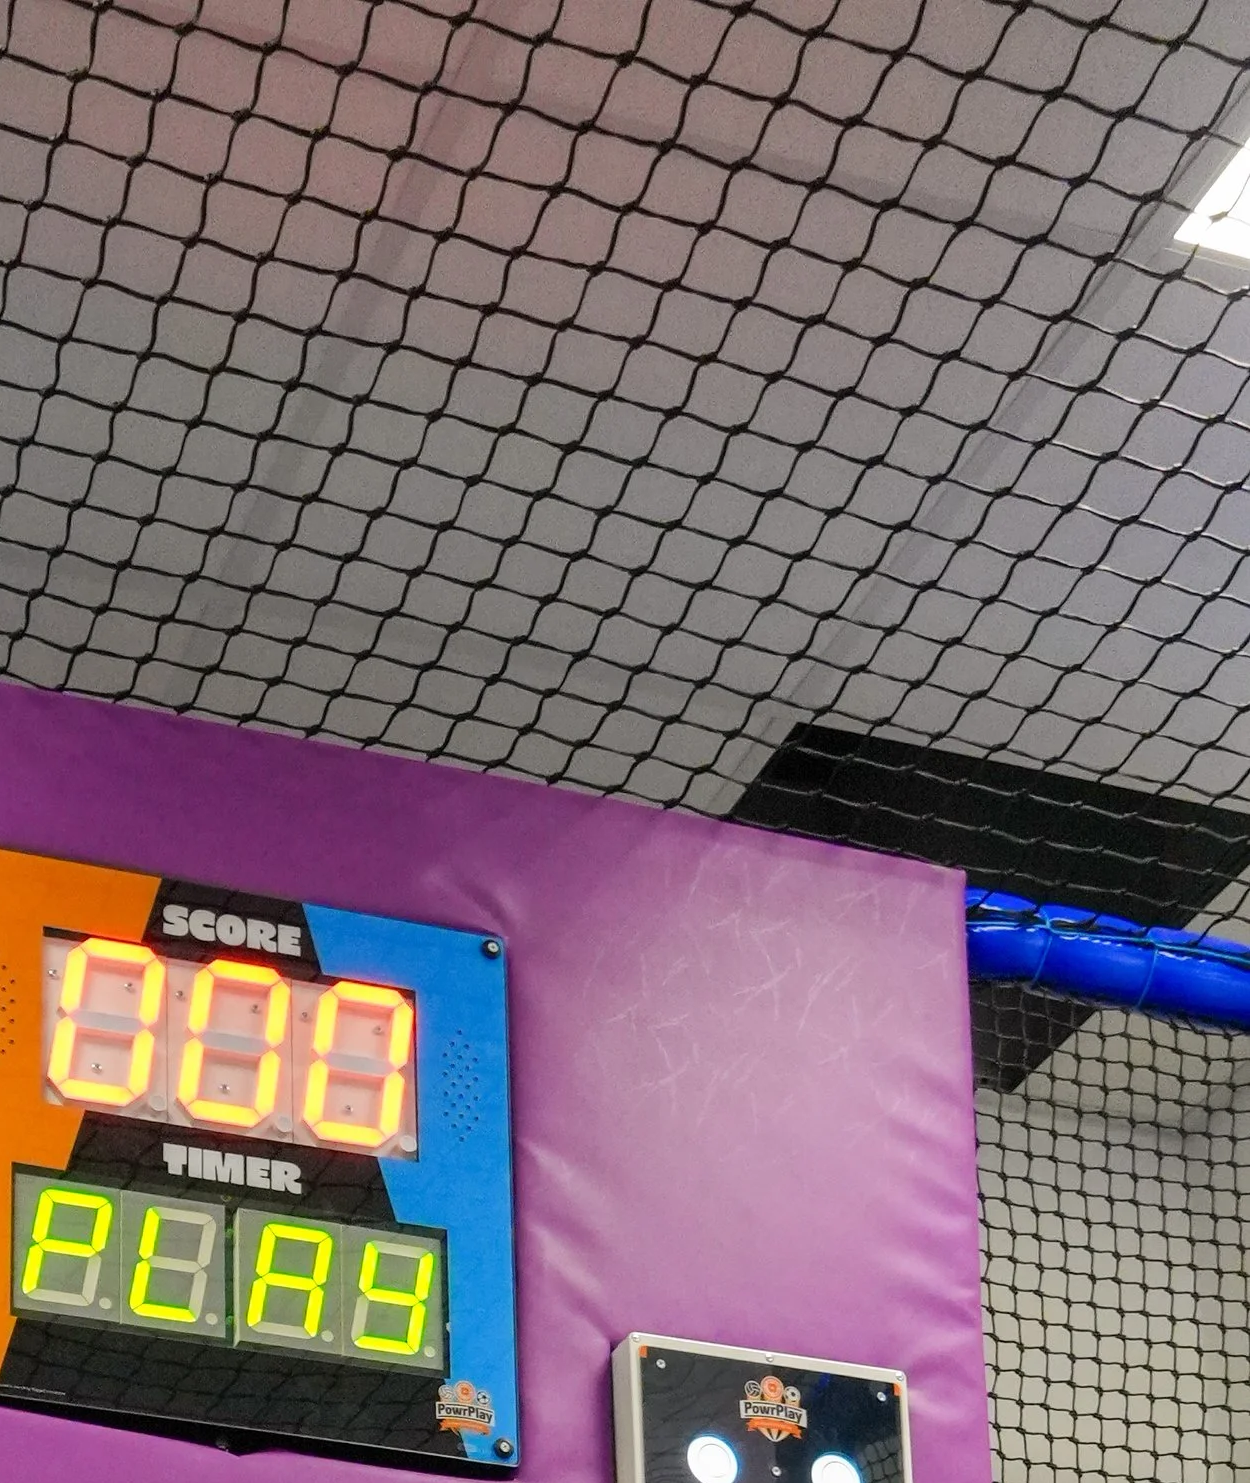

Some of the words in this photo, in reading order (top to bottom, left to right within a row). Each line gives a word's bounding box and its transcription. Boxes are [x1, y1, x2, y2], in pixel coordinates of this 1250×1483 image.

[162, 904, 302, 957] SCORE
[47, 935, 415, 1149] 000
[162, 1143, 303, 1195] TIMER
[438, 1403, 493, 1424] PowrPlay
[744, 1401, 803, 1424] PowrPlay
